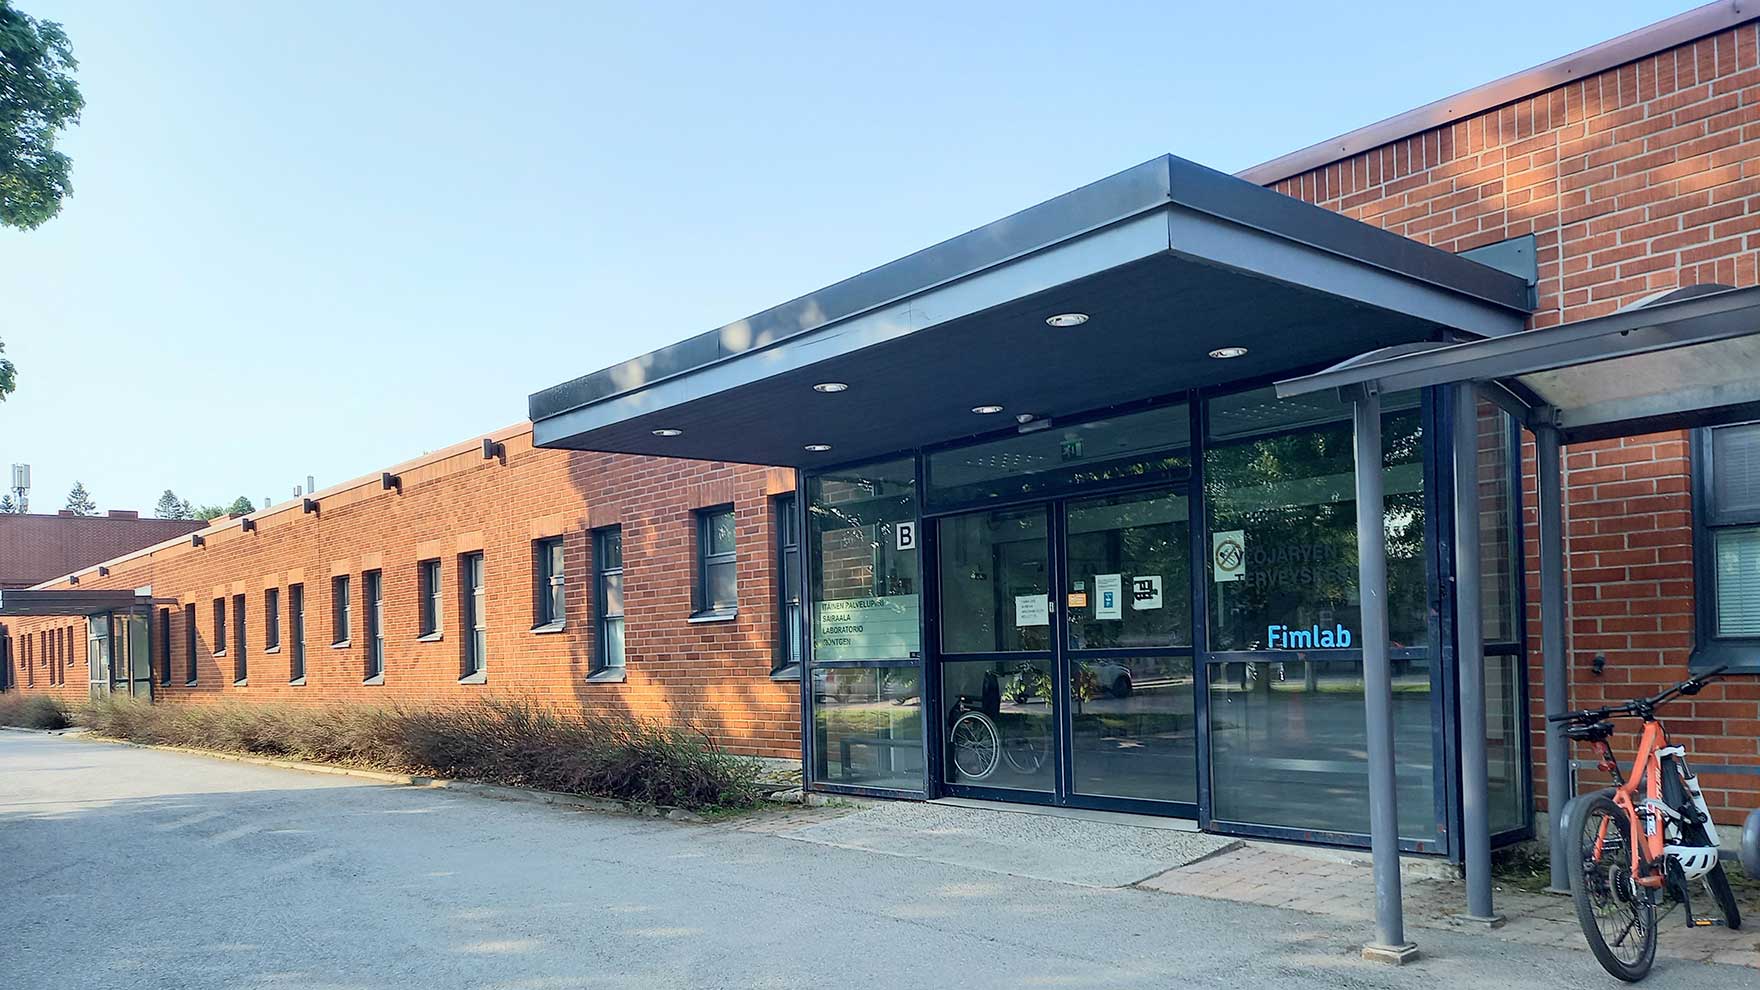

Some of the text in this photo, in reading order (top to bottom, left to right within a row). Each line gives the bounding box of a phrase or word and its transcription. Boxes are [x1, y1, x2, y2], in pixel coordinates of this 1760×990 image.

[901, 526, 912, 546] B
[822, 614, 850, 622] SAIRAALA
[822, 625, 863, 634] LABORATORIO
[1268, 624, 1350, 648] Fimlab
[823, 638, 851, 646] RÖNTGEN
